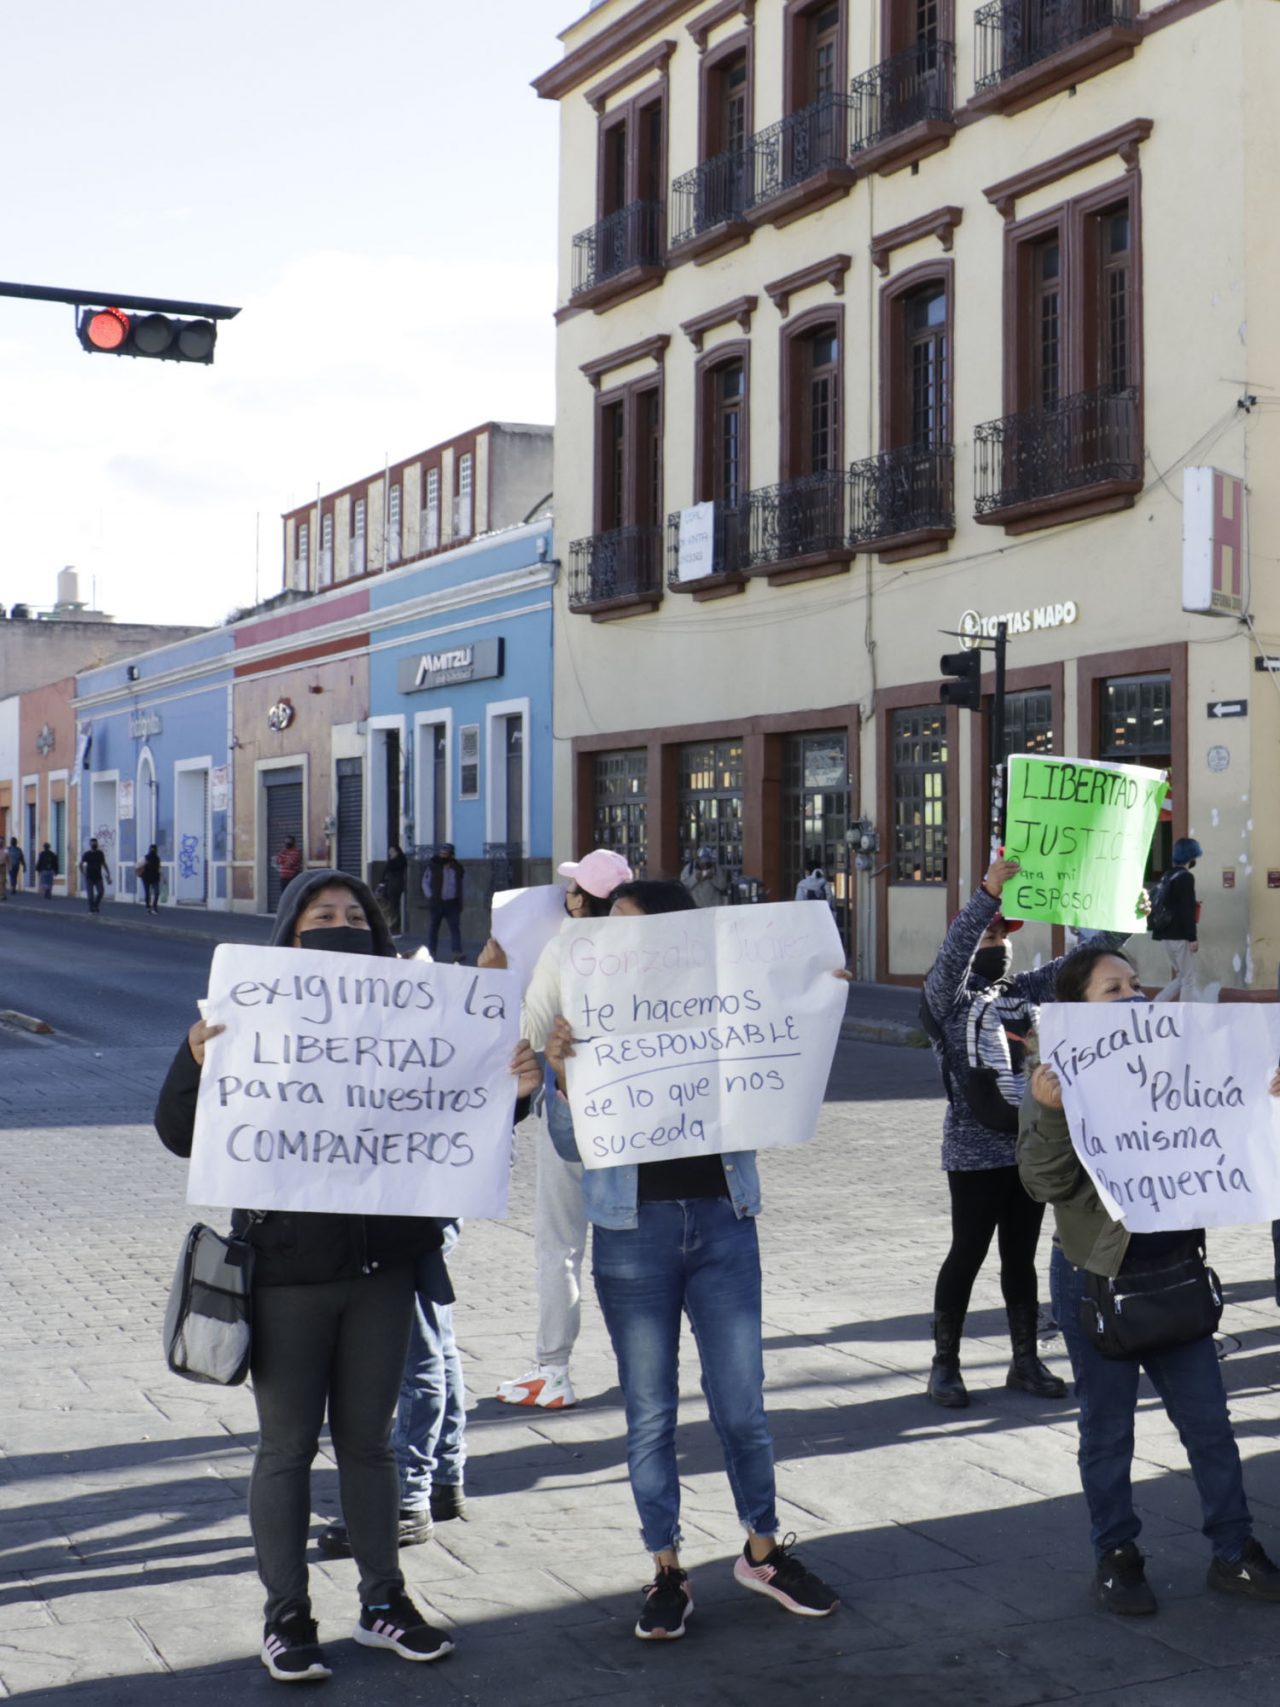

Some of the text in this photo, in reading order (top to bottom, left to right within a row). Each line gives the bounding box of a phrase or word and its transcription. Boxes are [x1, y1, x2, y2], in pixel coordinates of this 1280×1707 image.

[1033, 600, 1078, 630] MAPO
[1022, 762, 1138, 810] LIBERTAD
[1057, 868, 1076, 881] mi
[1016, 885, 1093, 911] ESPOSO
[569, 929, 707, 977] Gonzalo
[229, 975, 507, 1025] exigimos la
[581, 989, 762, 1032] te hacemos
[252, 1031, 456, 1072] LIBERTAD
[594, 1015, 800, 1067] RESPONSABLE
[1049, 1004, 1181, 1087] Fiscalía
[217, 1075, 489, 1113] para nuestros
[584, 1070, 785, 1118] de lo que nos
[1150, 1063, 1245, 1113] Policía
[225, 1124, 475, 1167] COMPAÑEROS
[592, 1113, 706, 1159] suceda
[1115, 1121, 1223, 1153] misma
